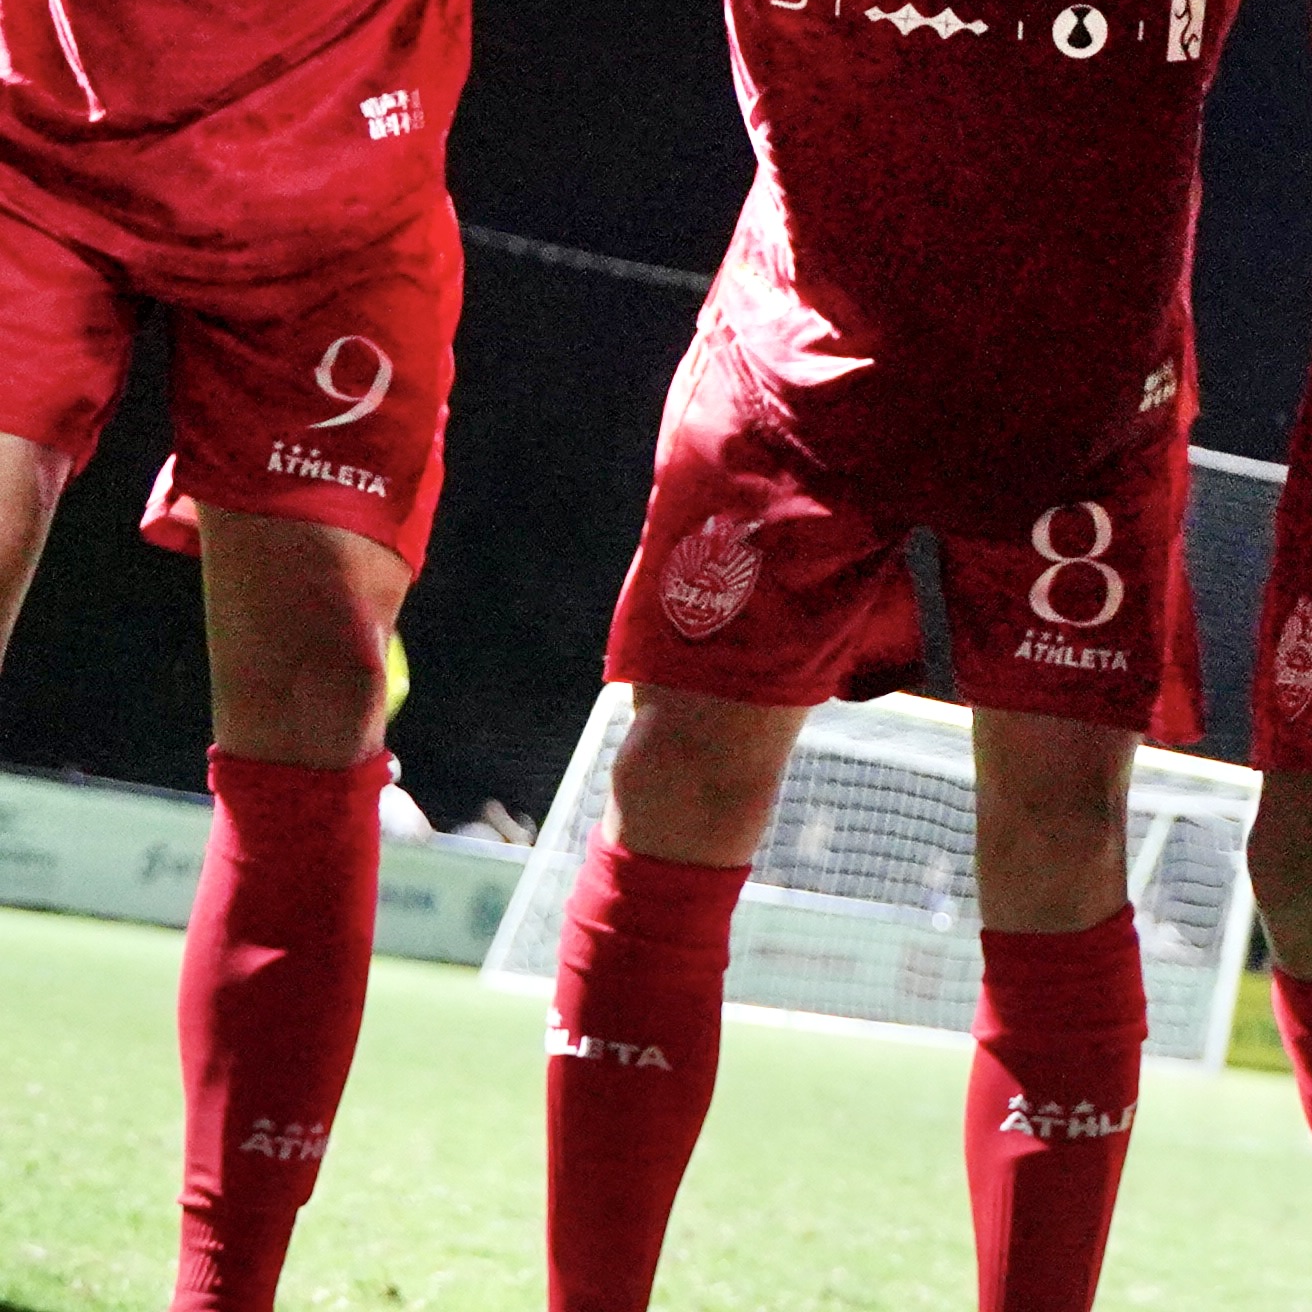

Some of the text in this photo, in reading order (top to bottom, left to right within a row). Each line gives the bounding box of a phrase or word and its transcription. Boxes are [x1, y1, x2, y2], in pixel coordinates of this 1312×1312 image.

[309, 336, 393, 429] 9
[267, 452, 387, 498] ATHLETA
[1028, 501, 1125, 628] 8
[1013, 641, 1128, 673] ATHLETA
